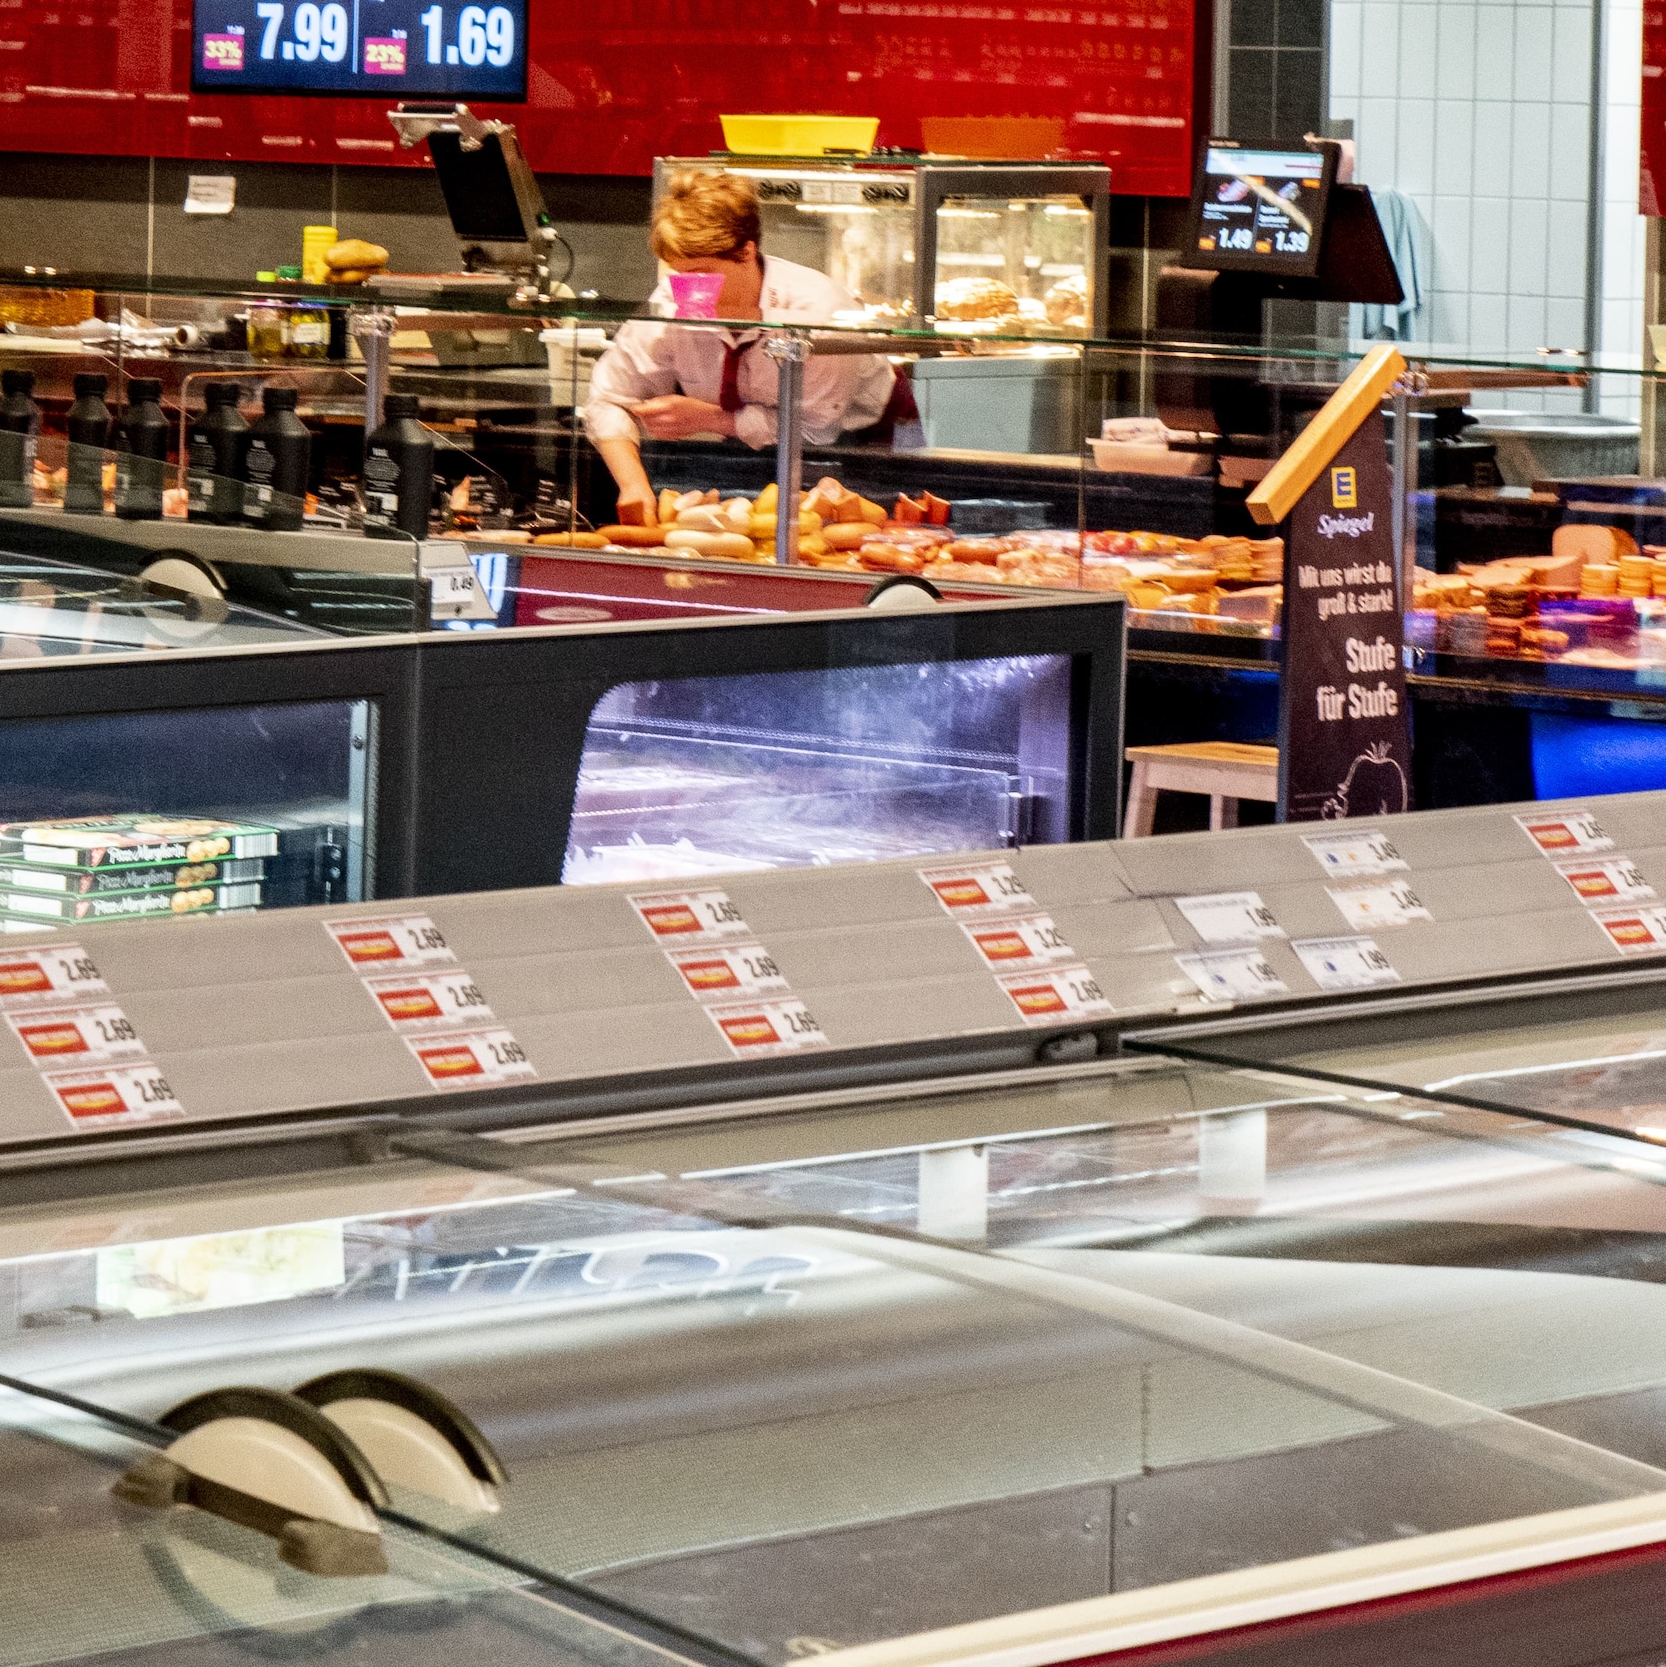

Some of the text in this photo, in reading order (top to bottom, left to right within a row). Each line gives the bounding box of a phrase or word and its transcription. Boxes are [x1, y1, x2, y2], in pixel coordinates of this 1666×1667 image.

[256, 2, 349, 63] 7.99
[420, 5, 515, 67] 1.69
[205, 39, 243, 60] 33%
[365, 44, 406, 64] 23%
[1219, 227, 1253, 250] 1.49
[1275, 230, 1310, 253] 1.39
[1317, 511, 1374, 538] Spiegel
[1298, 560, 1393, 588] Mit uns wirst du
[1347, 595, 1357, 614] &
[1357, 589, 1393, 613] stark!
[1346, 635, 1396, 673] Stufe
[1317, 682, 1398, 722] für Stufe
[1373, 841, 1401, 862] 3.49
[991, 875, 1025, 896] 3.29
[1618, 868, 1650, 888] 2.69
[1391, 890, 1424, 910] 3.49
[705, 900, 744, 924] 2.69
[1245, 907, 1278, 928] 1.99
[408, 927, 447, 951] 2.69
[58, 957, 102, 982] 2.69
[743, 955, 780, 978] 2.69
[1246, 962, 1278, 982] 1.99
[1358, 950, 1391, 971] 1.99
[447, 984, 486, 1008] 2.69
[1069, 981, 1104, 1003] 2.69
[95, 1018, 137, 1043] 2.69
[783, 1010, 821, 1033] 2.69
[487, 1040, 527, 1065] 2.69
[133, 1077, 176, 1103] 2.69
